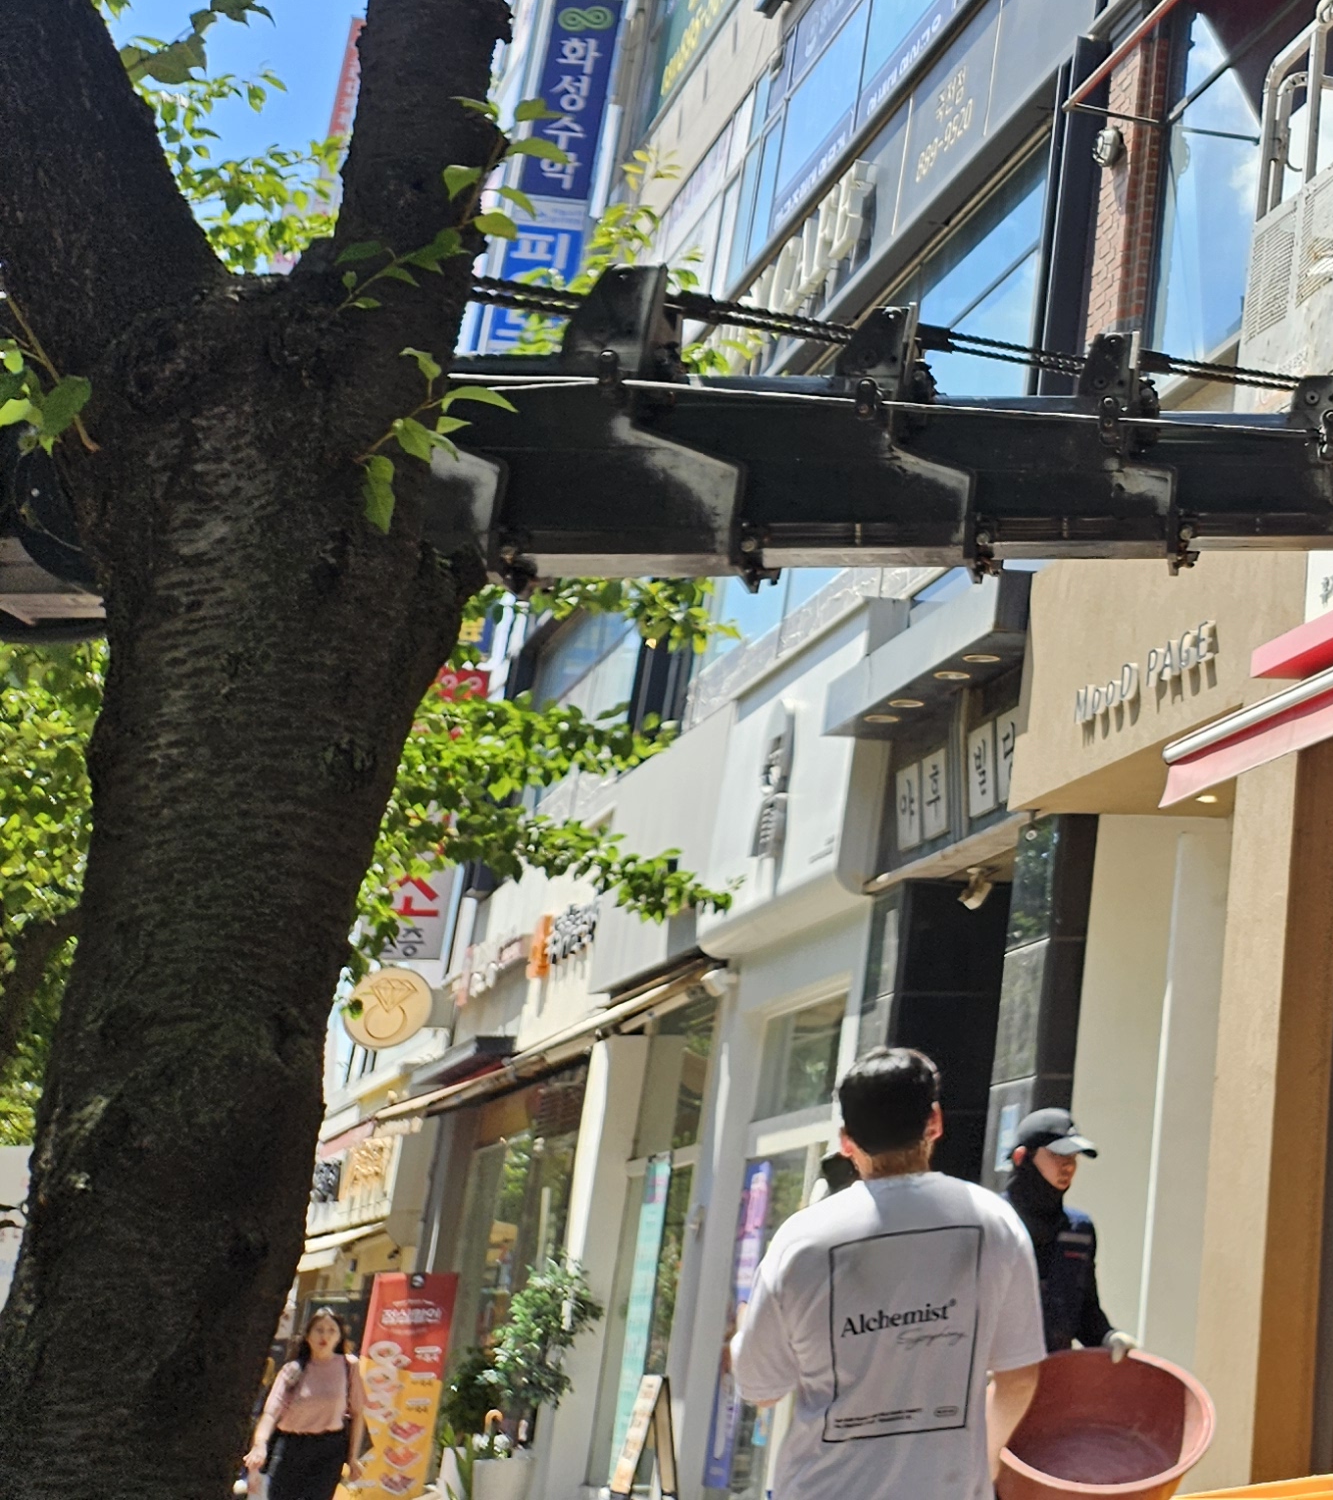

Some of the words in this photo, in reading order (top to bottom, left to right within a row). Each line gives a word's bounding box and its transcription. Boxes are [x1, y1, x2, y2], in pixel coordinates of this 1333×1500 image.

[538, 36, 603, 191] 화성수학
[1146, 619, 1217, 688] PAGE
[841, 1302, 950, 1338] Alchemist
